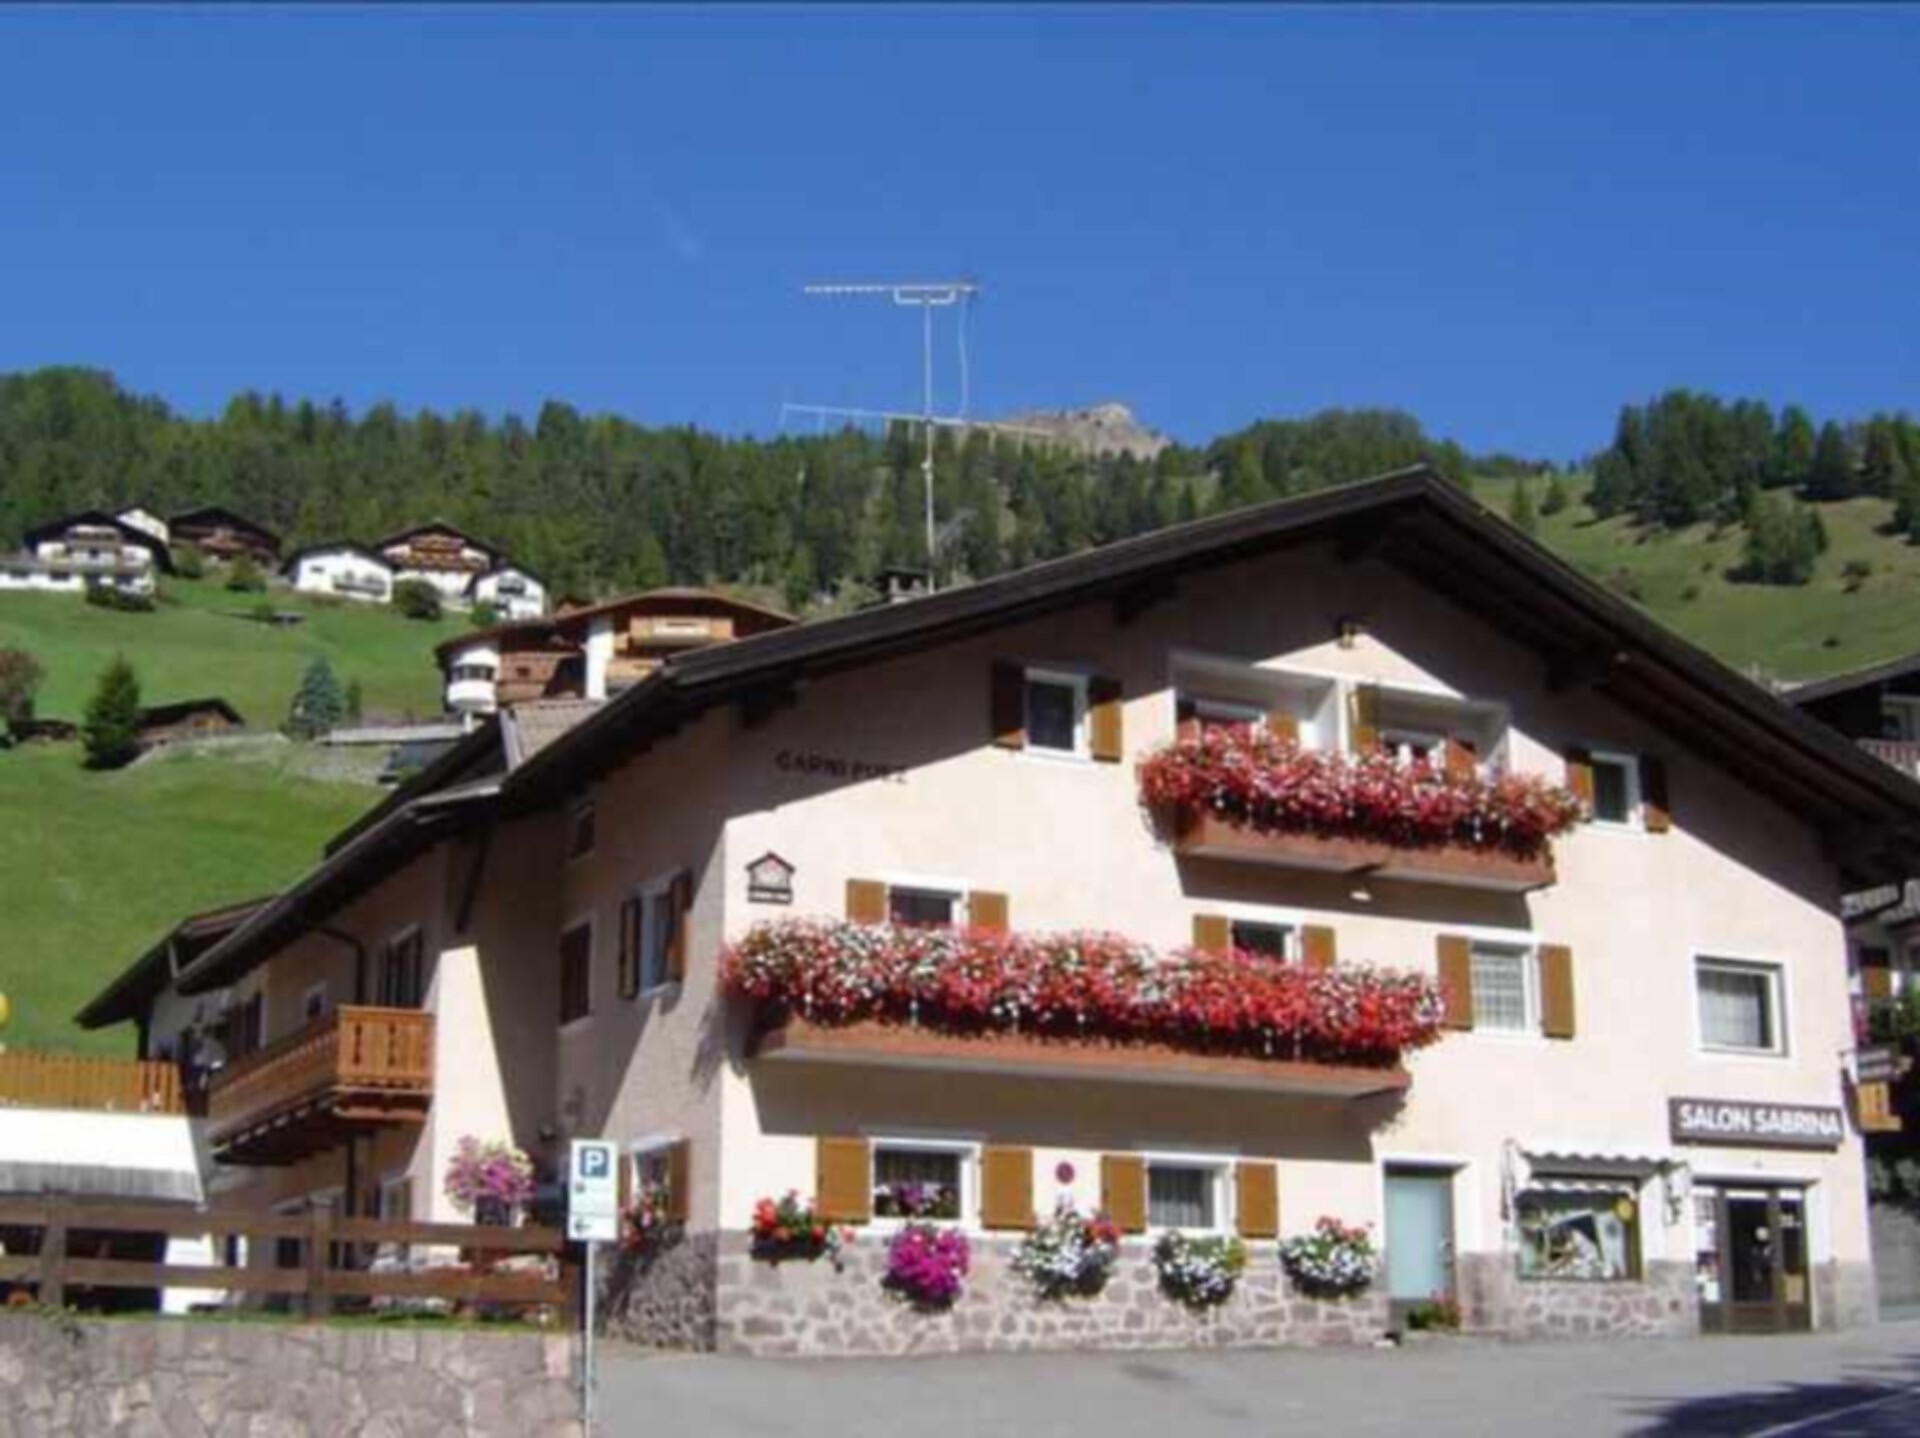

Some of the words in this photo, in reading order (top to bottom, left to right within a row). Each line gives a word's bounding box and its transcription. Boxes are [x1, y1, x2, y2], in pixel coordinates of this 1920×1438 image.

[1679, 1104, 1748, 1132] SALON
[1753, 1108, 1841, 1136] SABRINA
[584, 1150, 604, 1174] P
